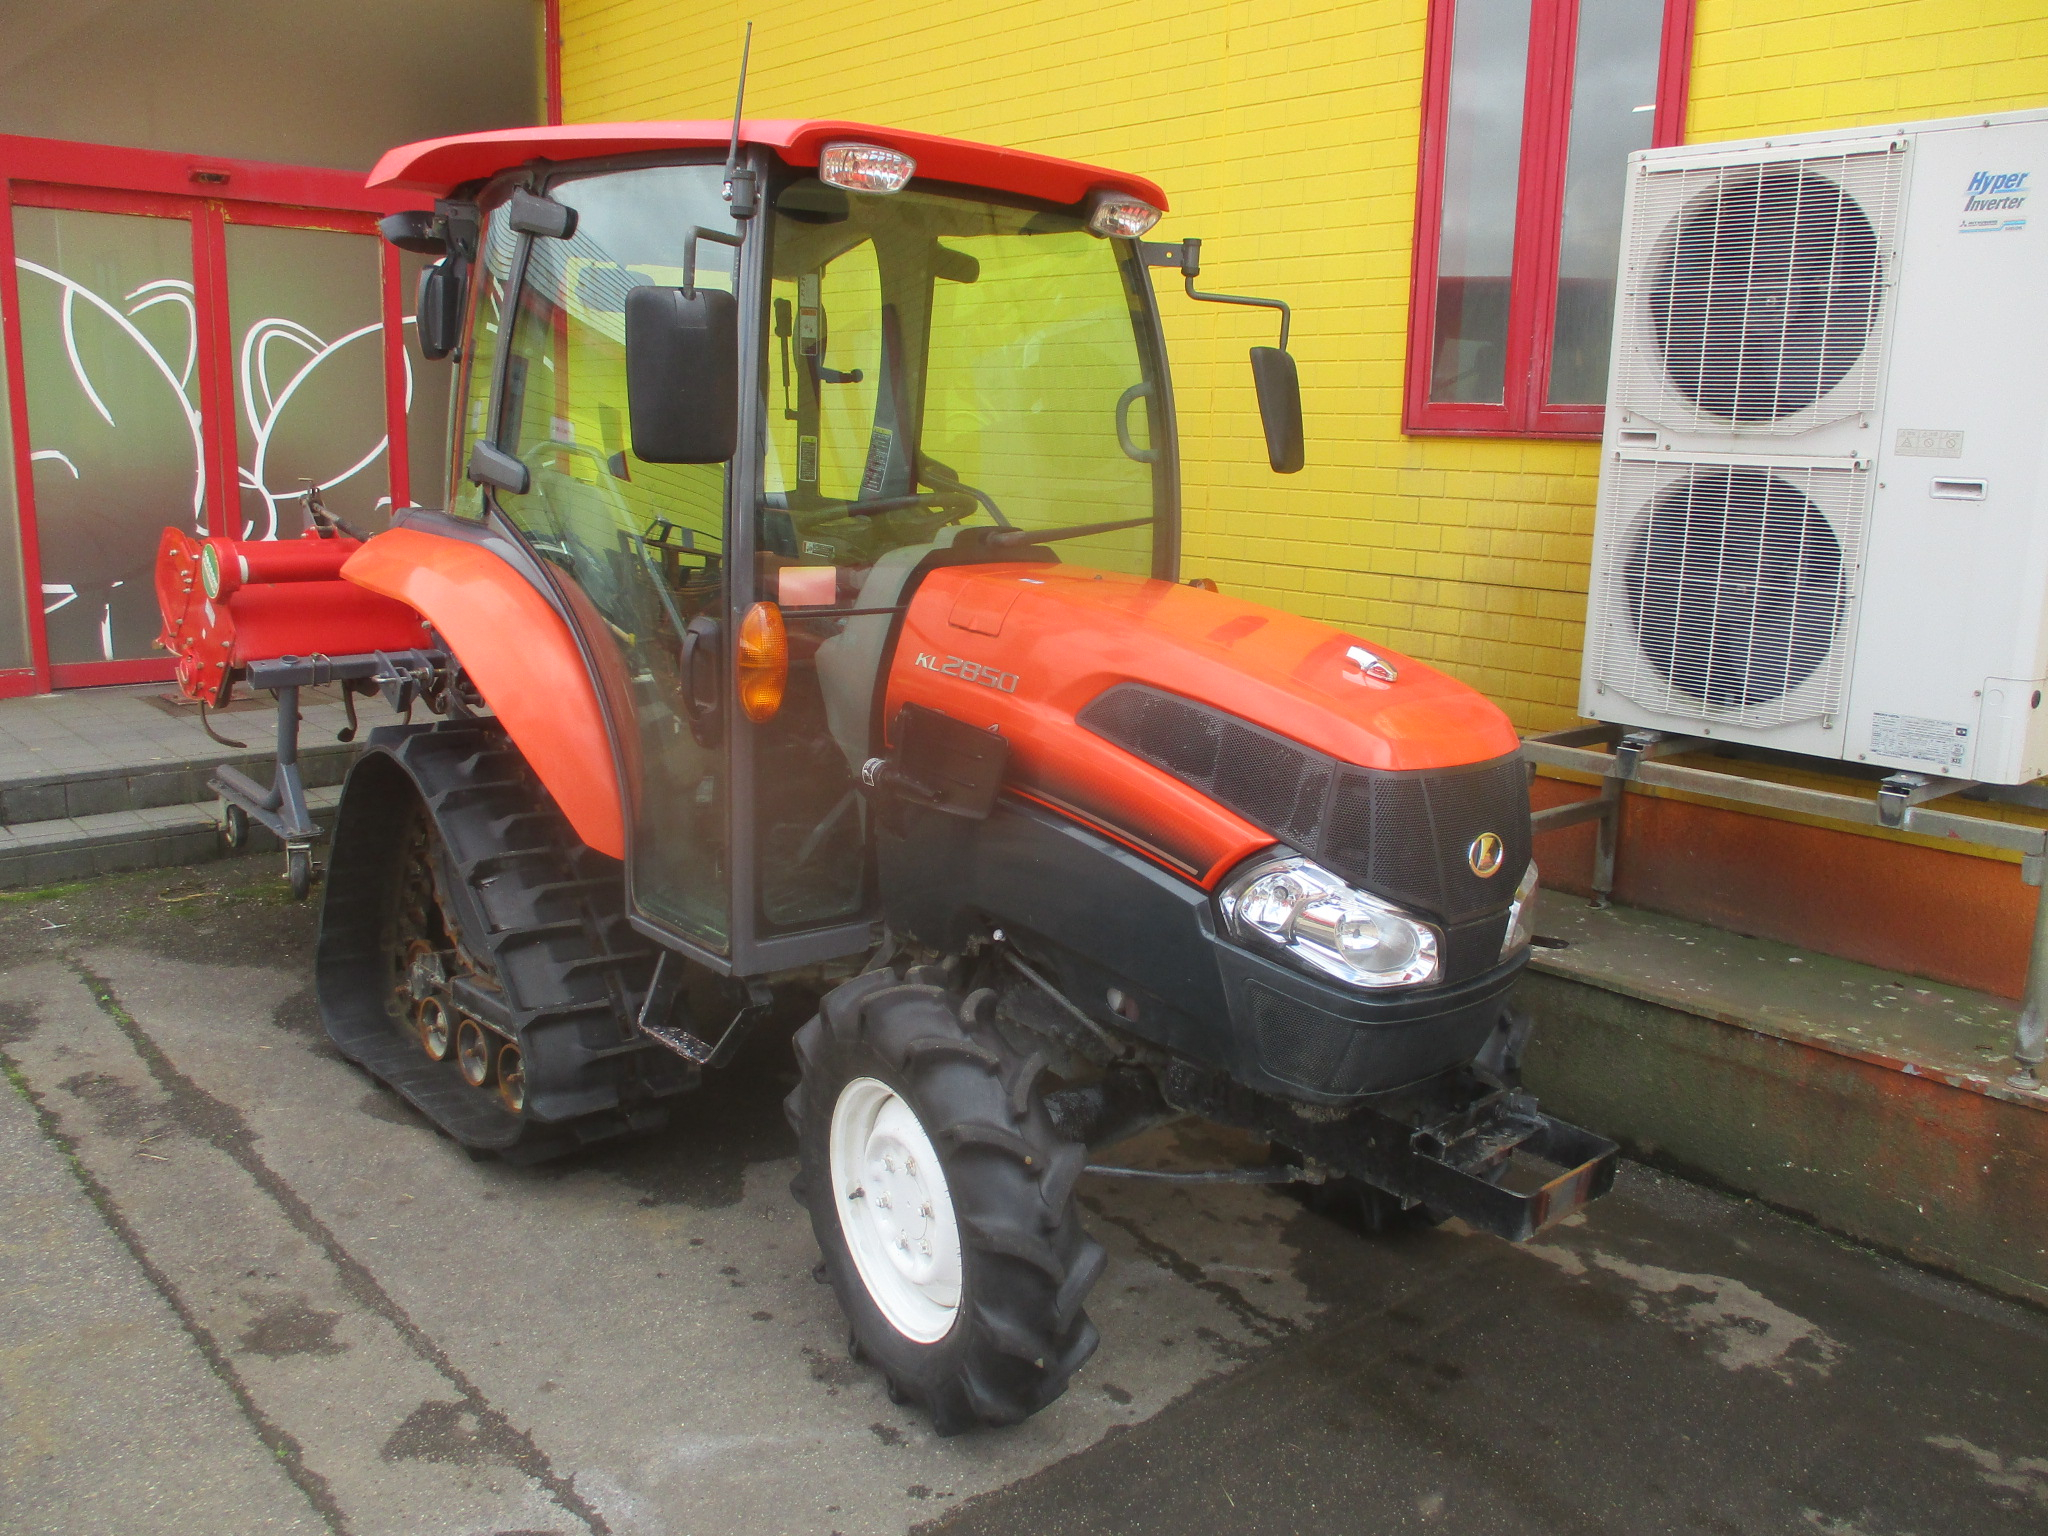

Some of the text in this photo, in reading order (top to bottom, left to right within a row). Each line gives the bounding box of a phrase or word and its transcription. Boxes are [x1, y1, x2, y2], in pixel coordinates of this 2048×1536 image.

[1966, 171, 2030, 194] Hyper
[1963, 196, 2026, 212] Inverter
[914, 652, 1020, 694] KL2850
